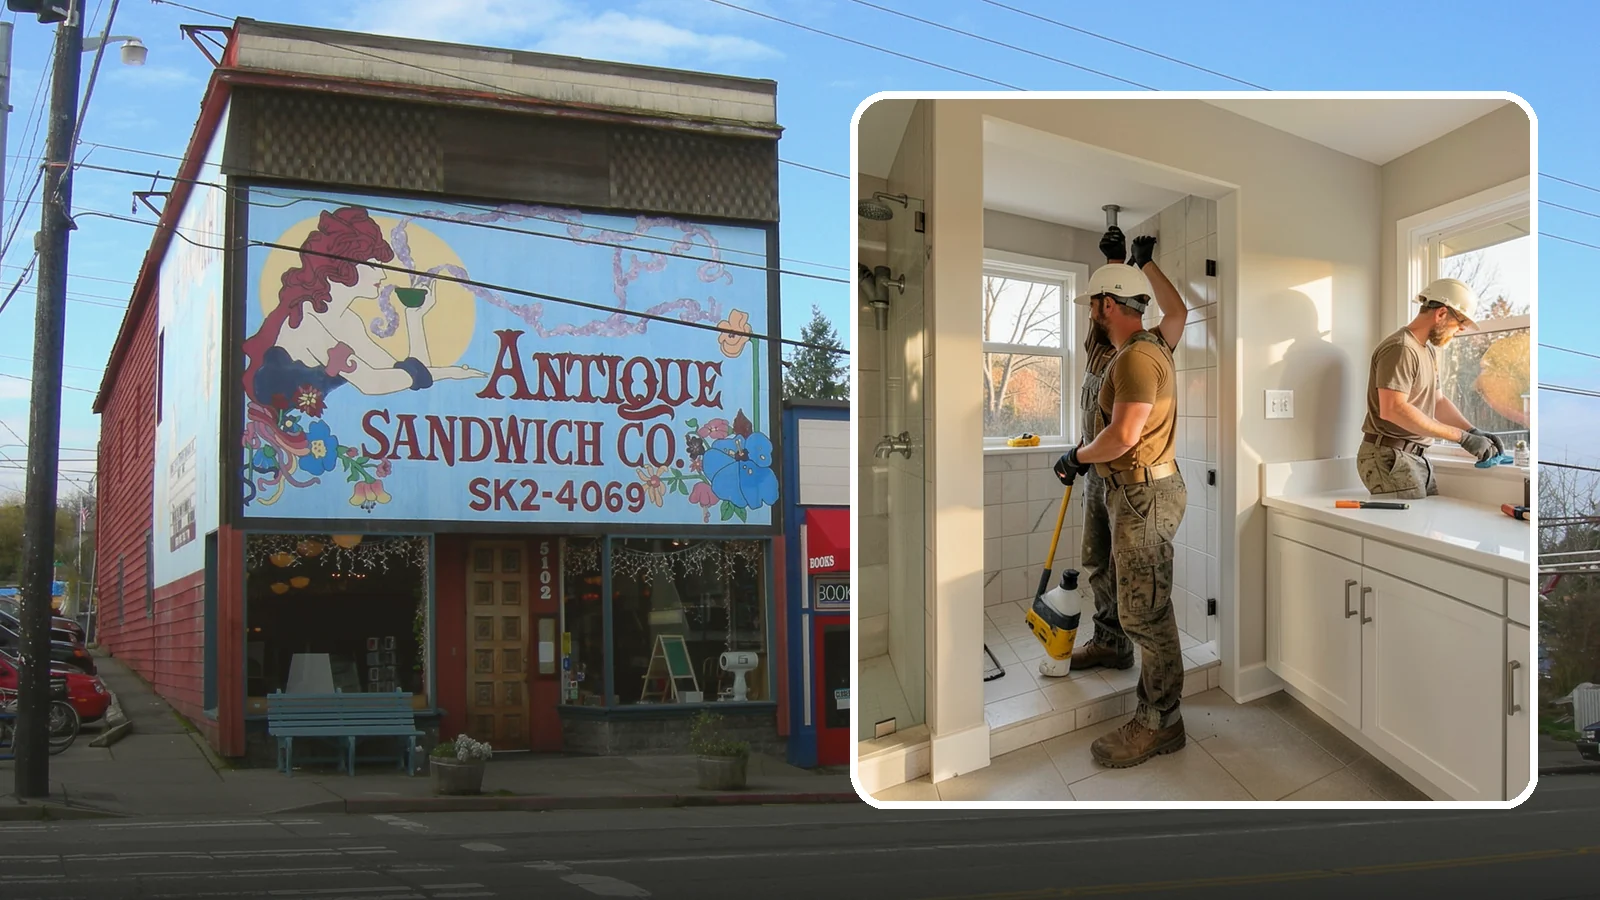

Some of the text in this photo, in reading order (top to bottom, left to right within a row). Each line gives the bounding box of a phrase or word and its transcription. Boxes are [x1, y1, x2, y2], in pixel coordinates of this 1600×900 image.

[476, 329, 723, 421] ANTIQUE
[361, 409, 685, 469] SANDWICH CO.
[468, 477, 645, 513] SK2-4069
[539, 541, 553, 600] 5102
[809, 554, 835, 568] BOOKS
